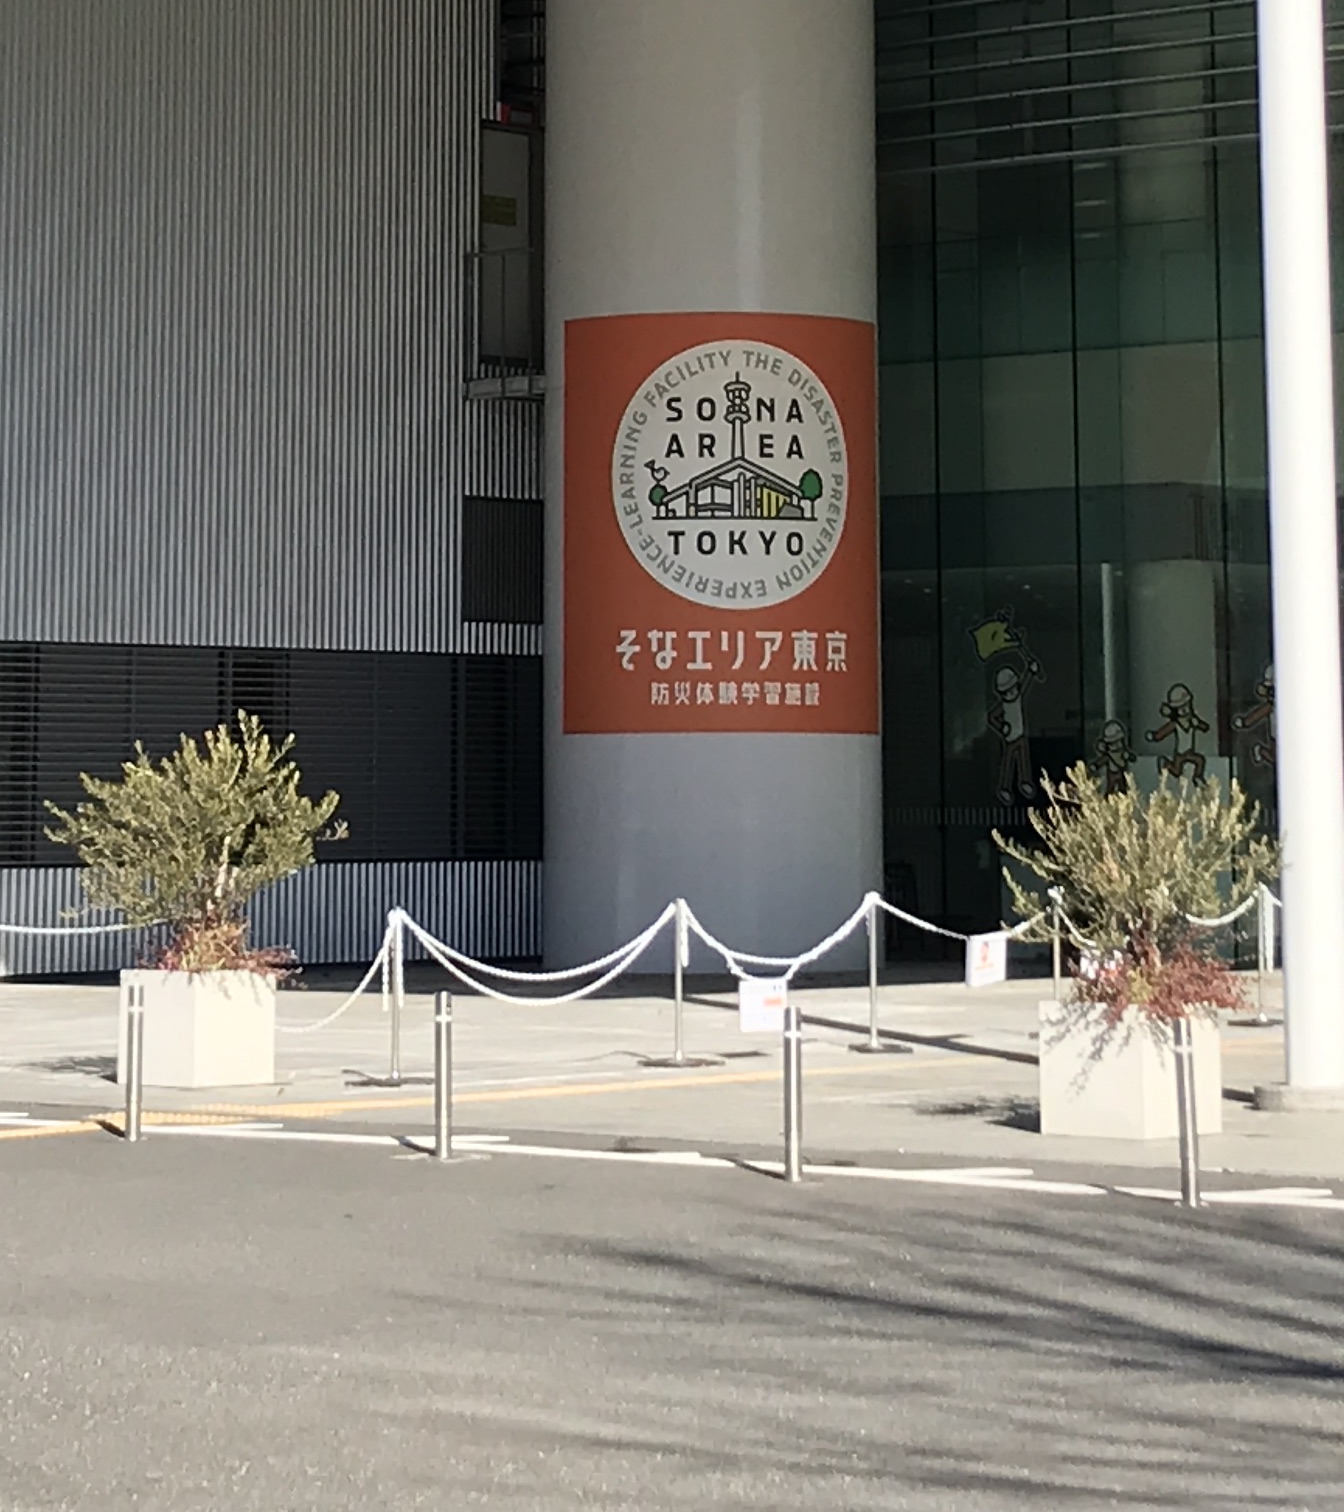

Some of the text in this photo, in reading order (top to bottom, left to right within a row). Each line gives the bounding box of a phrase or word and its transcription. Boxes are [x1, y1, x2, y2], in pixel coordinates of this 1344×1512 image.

[643, 350, 731, 408] FACILITY
[742, 350, 783, 376] THE
[787, 368, 844, 464] DISASTER
[667, 530, 804, 556] TOKYO
[775, 473, 844, 592] PREVENTION
[615, 629, 848, 672] そなエリア東京
[650, 680, 820, 706] 防災体験学習施設
